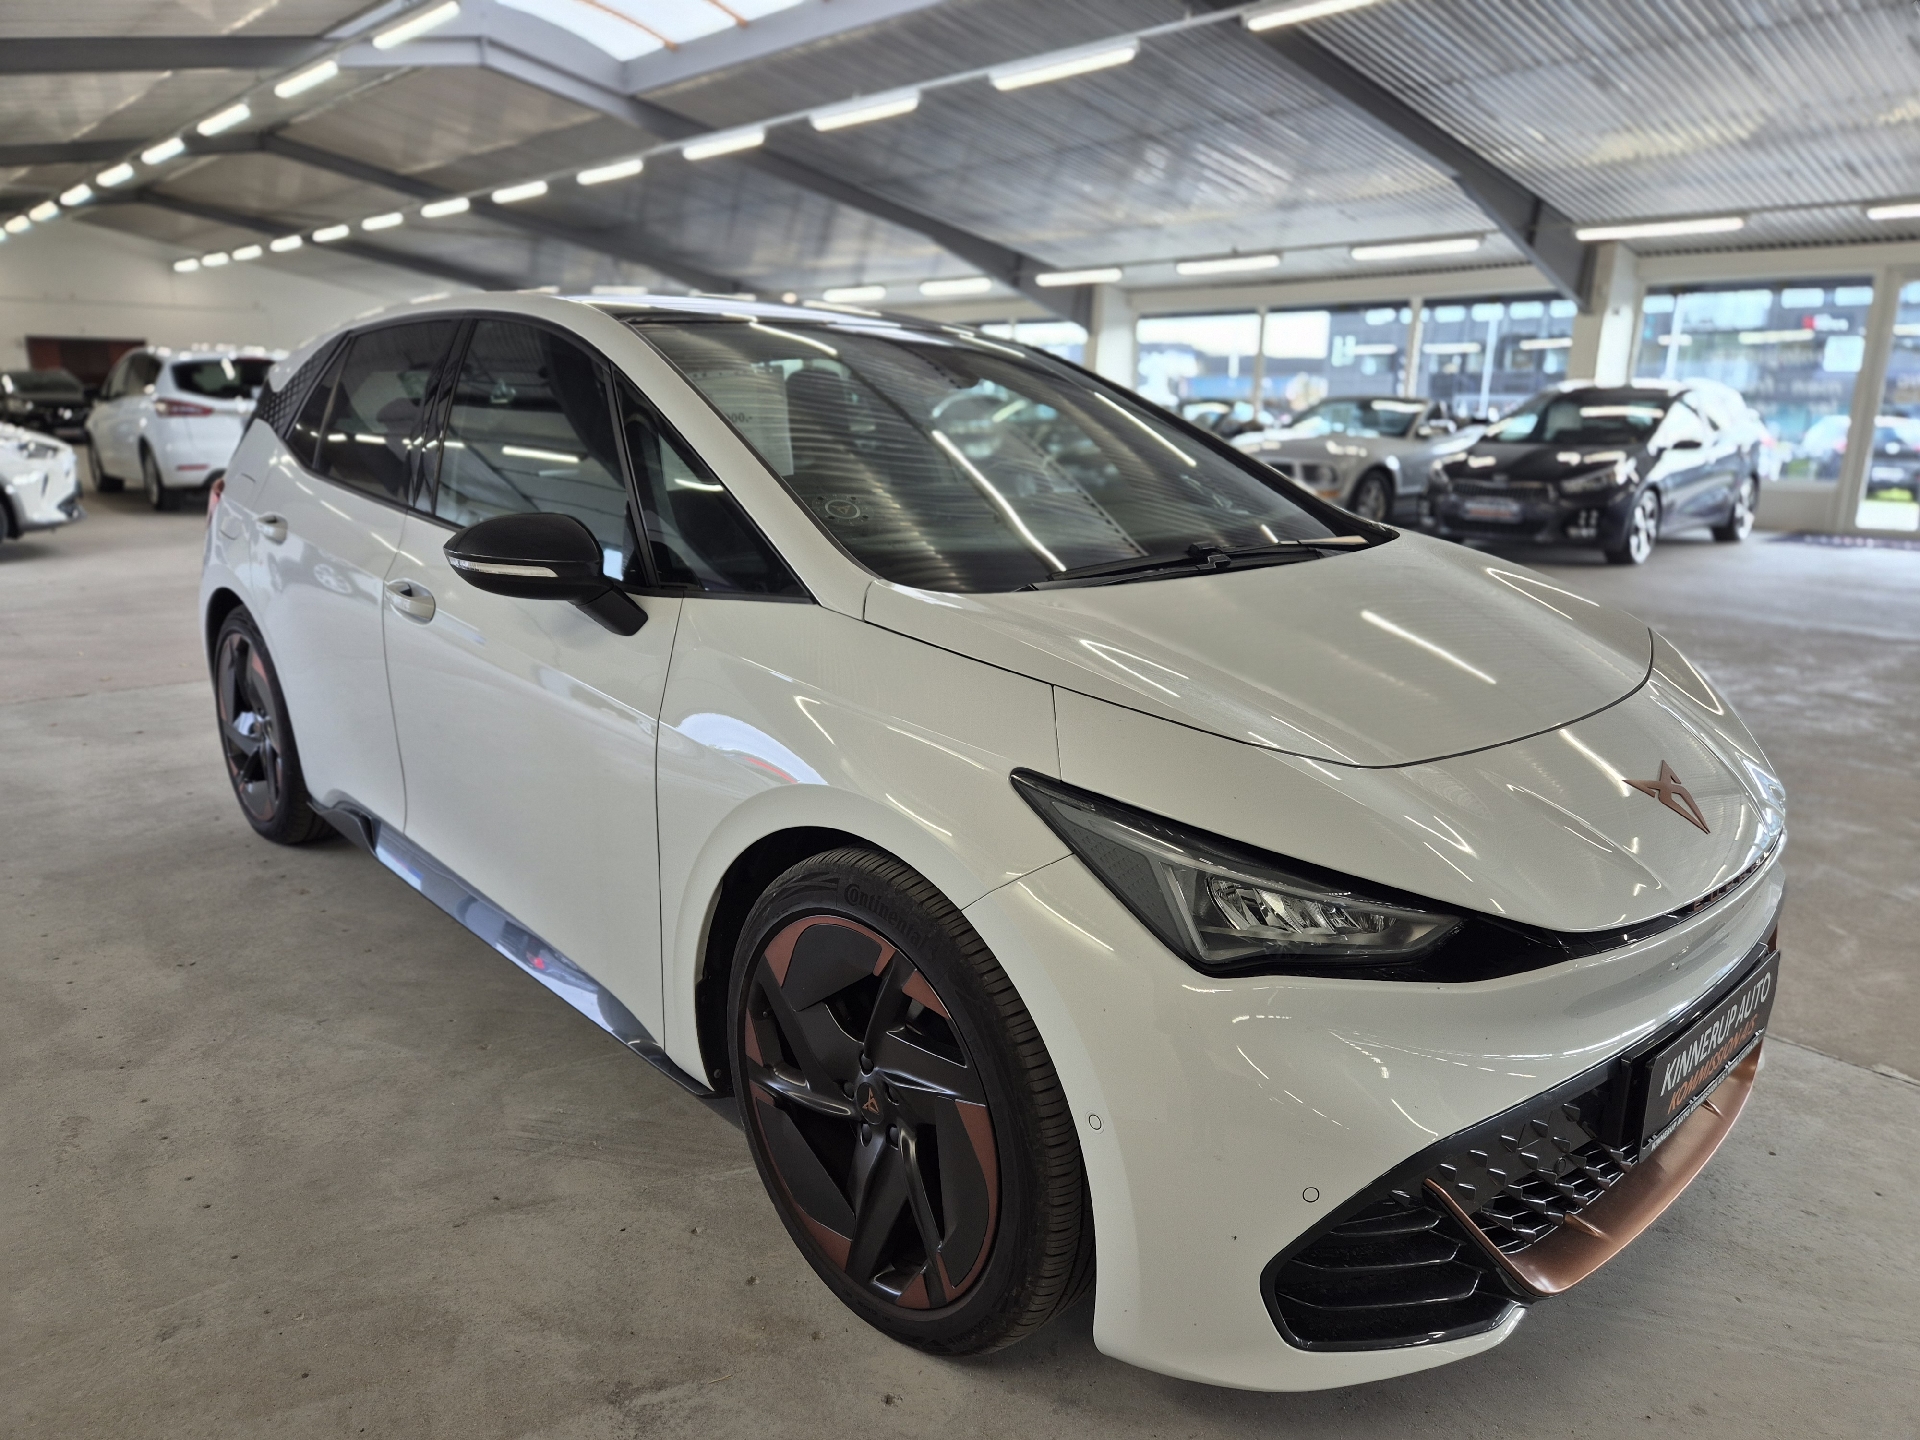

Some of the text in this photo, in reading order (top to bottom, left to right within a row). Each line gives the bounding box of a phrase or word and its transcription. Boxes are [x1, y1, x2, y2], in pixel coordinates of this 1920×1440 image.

[1659, 1003, 1738, 1097] KINNERUP
[1733, 971, 1770, 1029] AUTO
[1665, 1029, 1743, 1116] KOMMISSION
